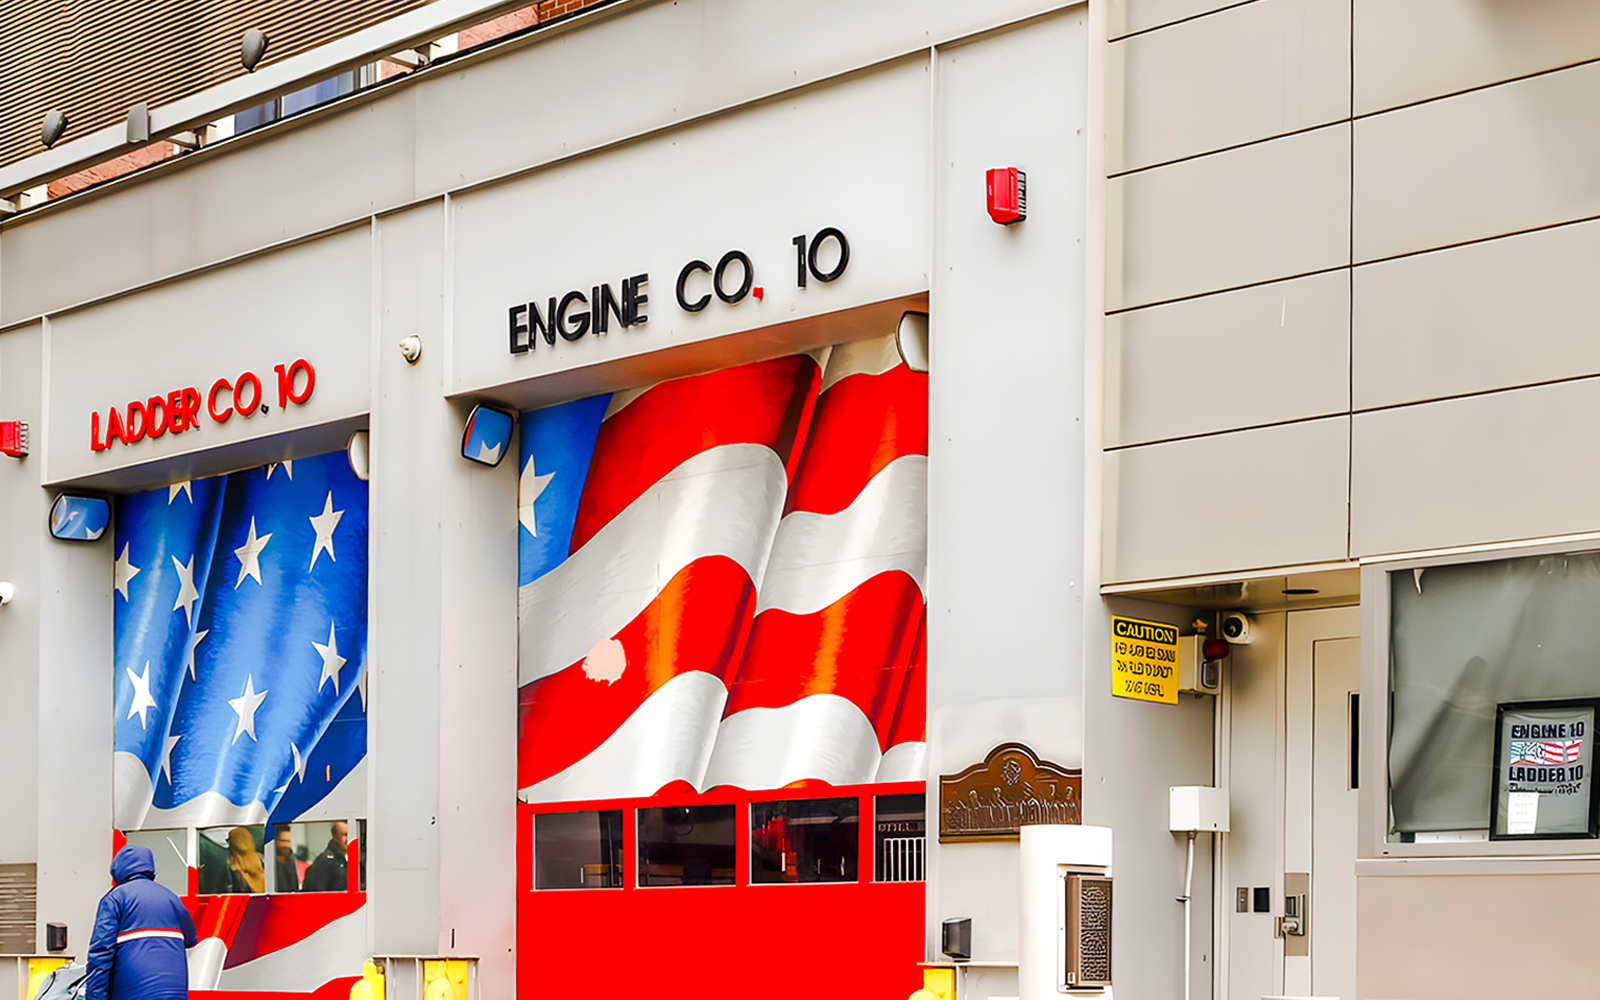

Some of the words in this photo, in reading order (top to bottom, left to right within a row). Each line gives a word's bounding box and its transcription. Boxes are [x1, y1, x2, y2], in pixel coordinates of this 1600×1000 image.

[508, 272, 649, 356] ENGINE
[675, 249, 764, 314] CO.
[792, 226, 851, 289] 10
[90, 385, 201, 451] LADDER
[207, 371, 269, 423] CO.
[274, 358, 316, 407] 10
[1116, 622, 1173, 643] CAUTION
[1511, 723, 1567, 739] ENGINE
[1569, 721, 1585, 738] 10
[1509, 765, 1565, 781] LADDER
[1569, 764, 1584, 780] 10
